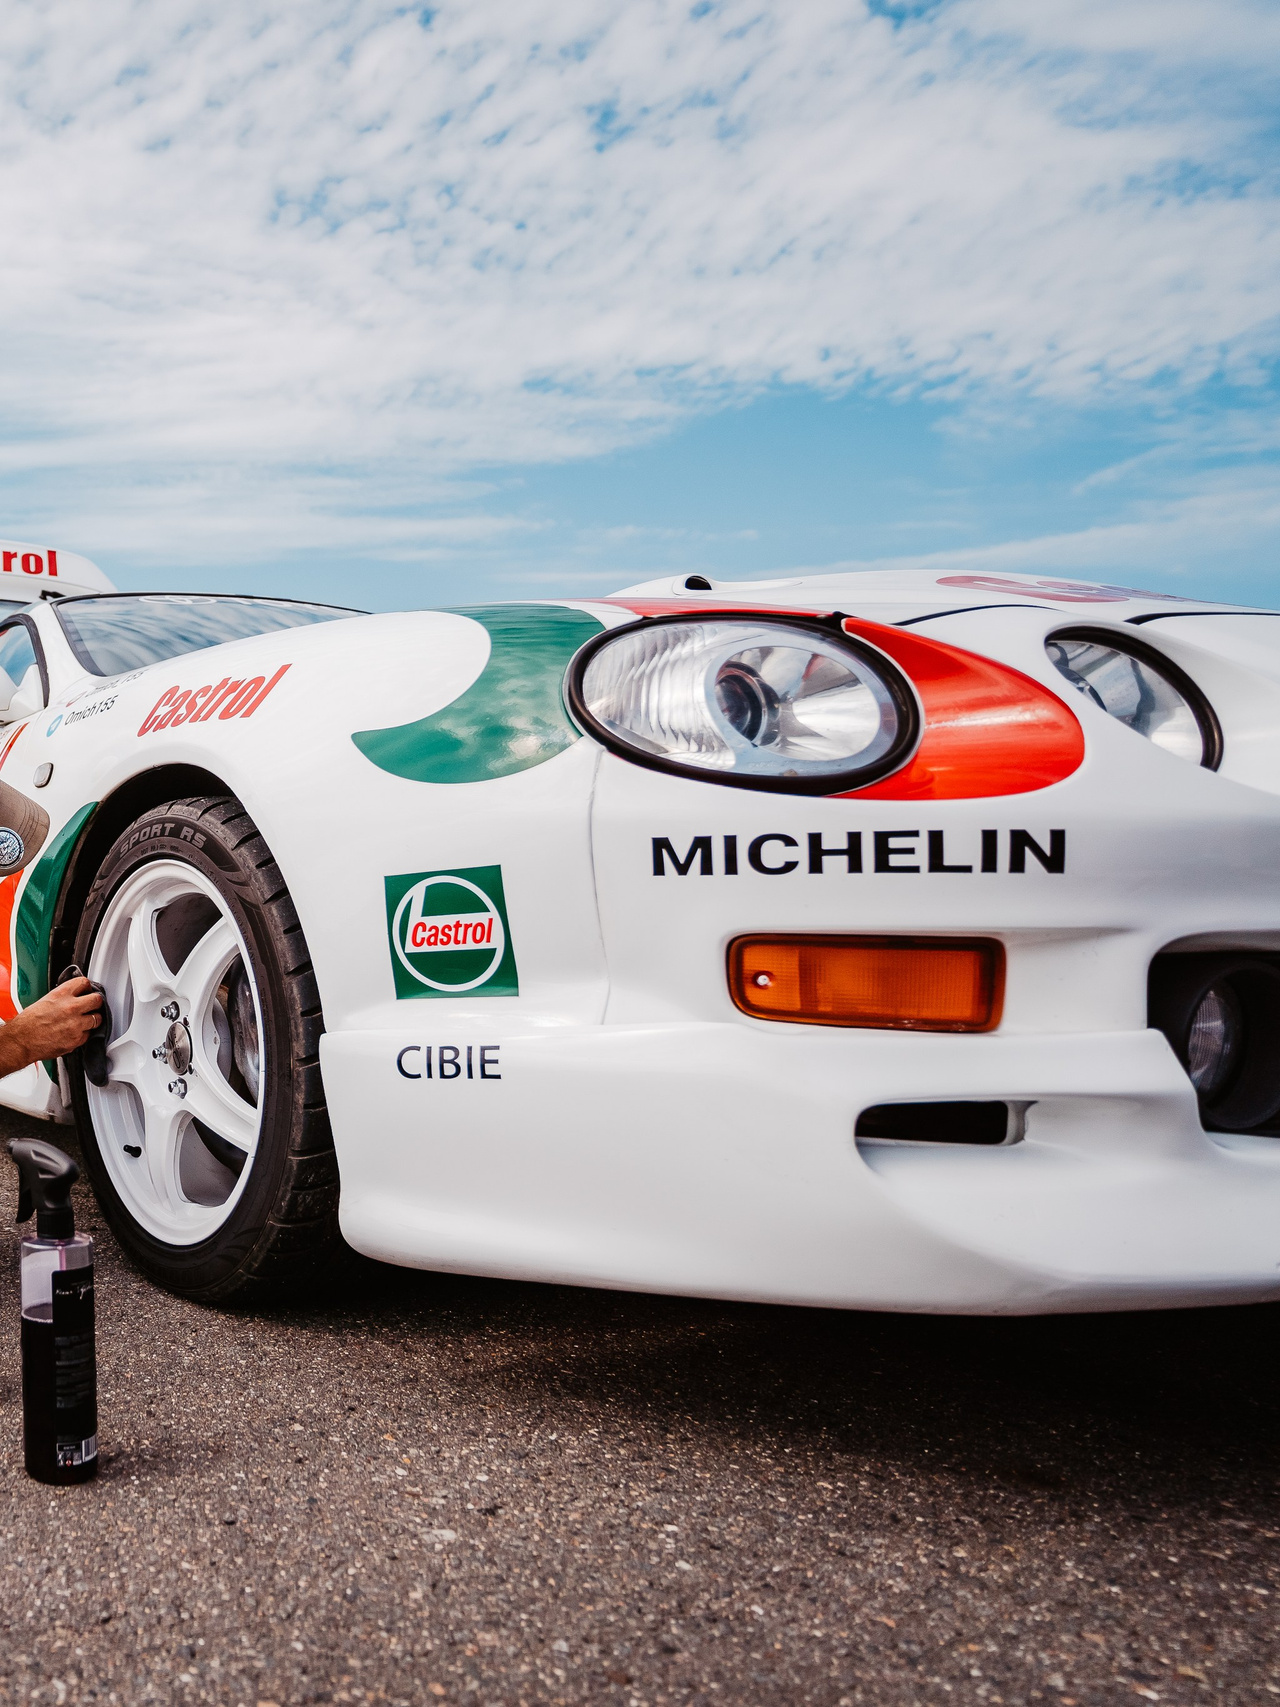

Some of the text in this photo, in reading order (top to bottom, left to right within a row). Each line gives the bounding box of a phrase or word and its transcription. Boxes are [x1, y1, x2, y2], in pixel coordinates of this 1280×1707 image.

[65, 694, 119, 726] Omich155
[137, 663, 293, 737] Castrol
[120, 823, 176, 854] SPORT
[180, 826, 207, 849] RS
[651, 829, 1066, 876] MICHELIN
[411, 917, 493, 947] Castrol
[396, 1045, 501, 1079] CIBIE
